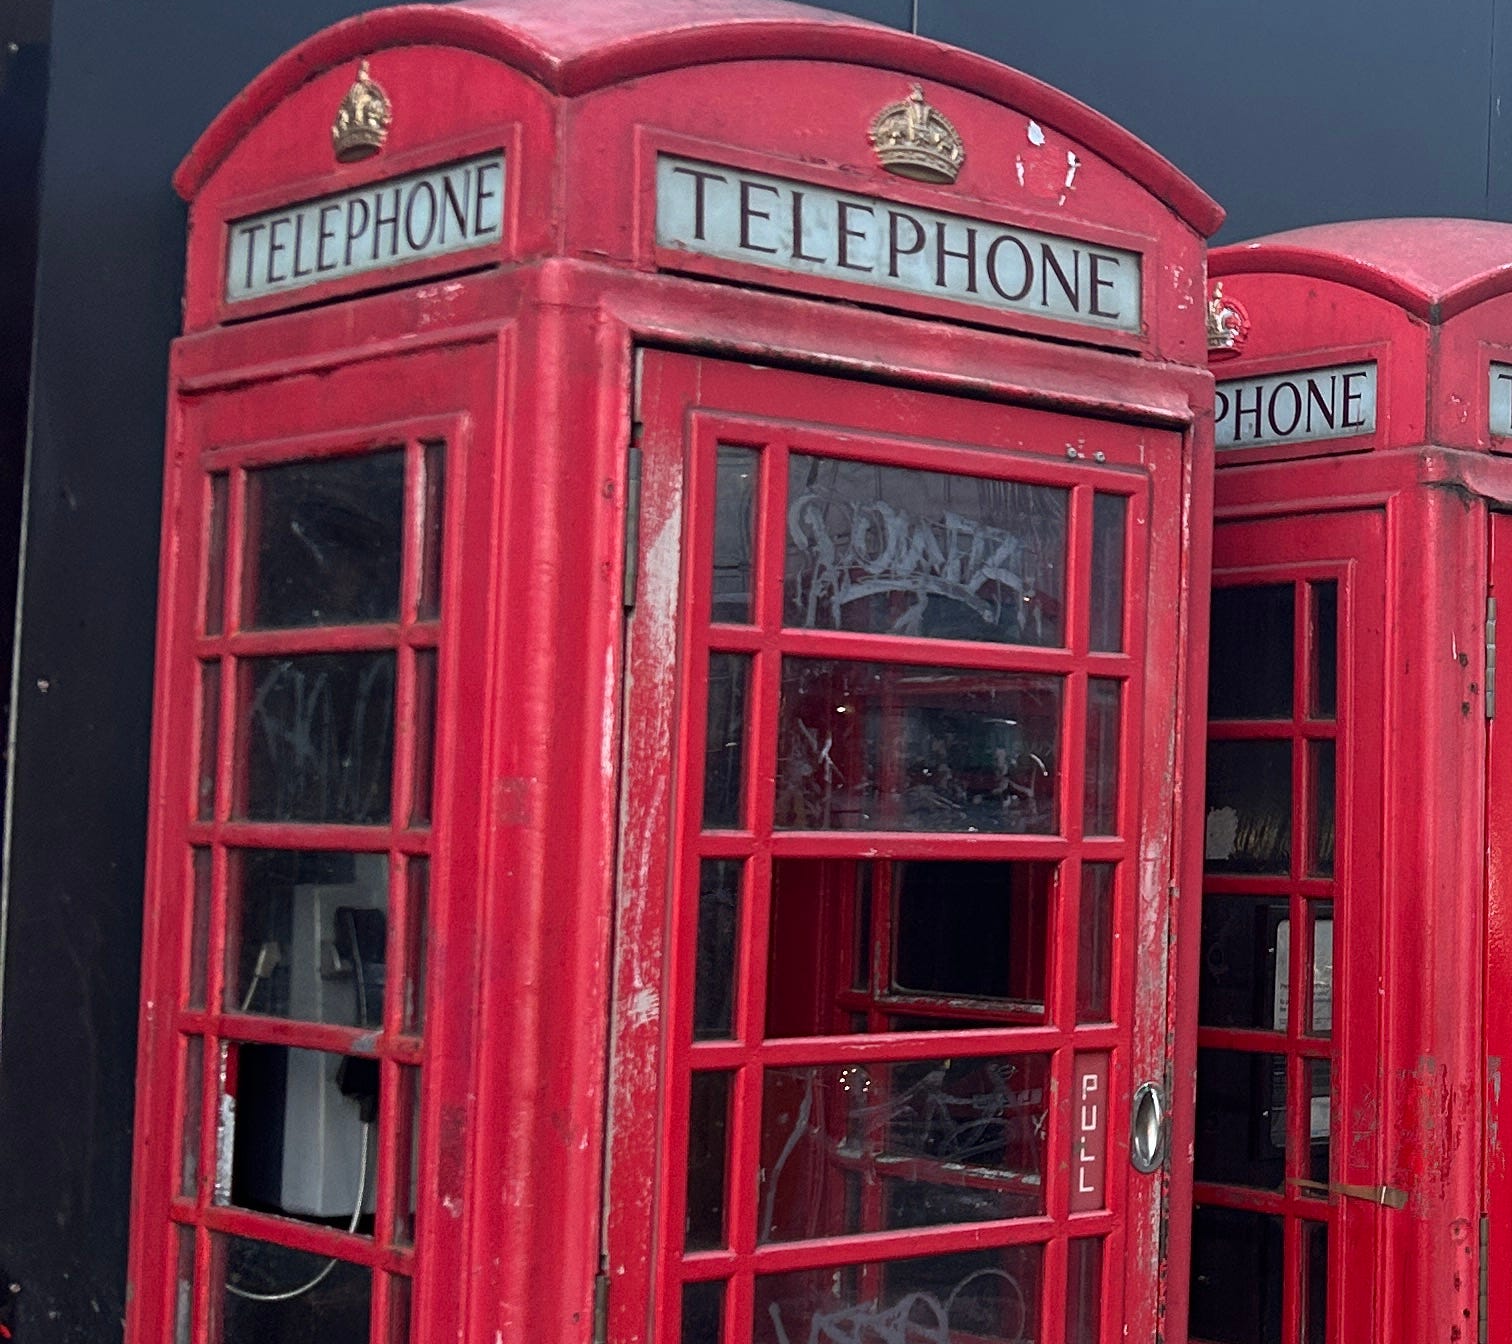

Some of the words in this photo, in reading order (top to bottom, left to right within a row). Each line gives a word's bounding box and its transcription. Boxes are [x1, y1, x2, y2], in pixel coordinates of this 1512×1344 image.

[240, 161, 497, 289] TELEPHONE
[672, 166, 1122, 319] TELEPHONE
[1079, 1074, 1098, 1192] PULL
